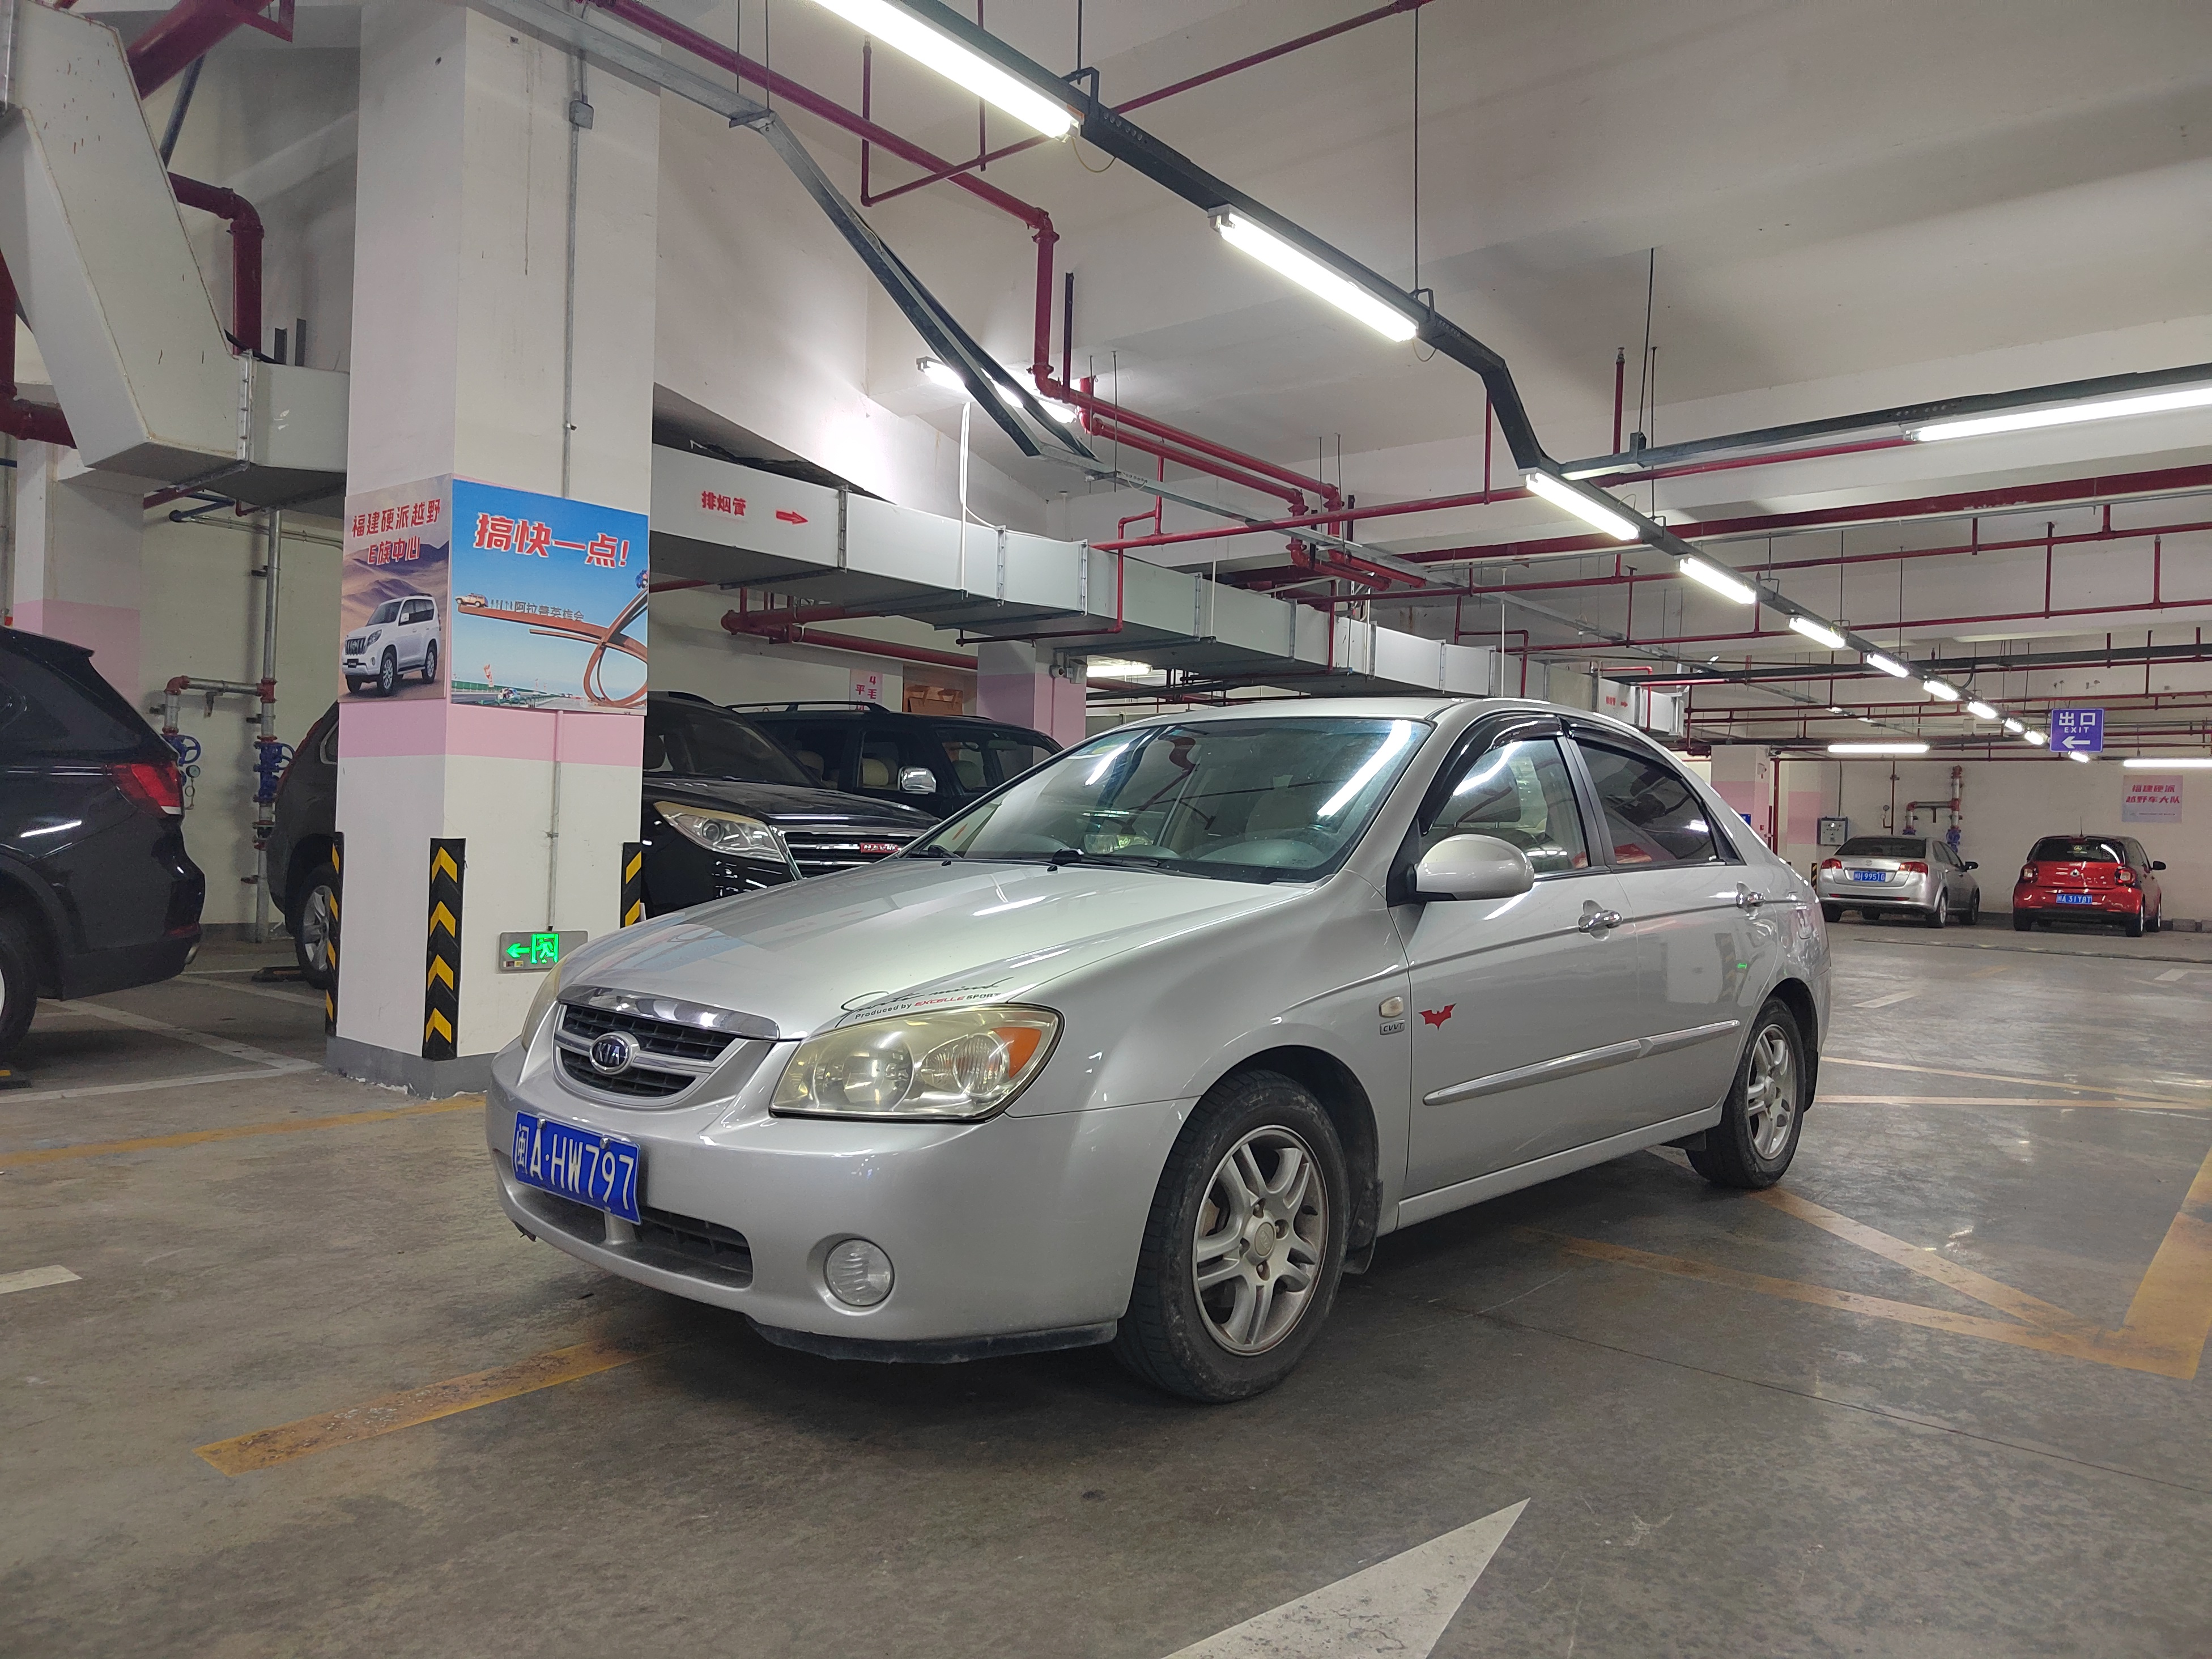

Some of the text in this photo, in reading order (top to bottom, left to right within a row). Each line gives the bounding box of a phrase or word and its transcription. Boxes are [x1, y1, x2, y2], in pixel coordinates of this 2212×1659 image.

[351, 499, 441, 538] 福建硬派越野
[368, 535, 420, 565] E族中心
[514, 601, 584, 622] 阿拉善英雄会
[2058, 712, 2096, 726] 出口
[854, 1005, 899, 1020] Produced
[914, 996, 965, 1007] EXCELLE
[1383, 1022, 1404, 1032] CVVT
[595, 1042, 621, 1065] KIA
